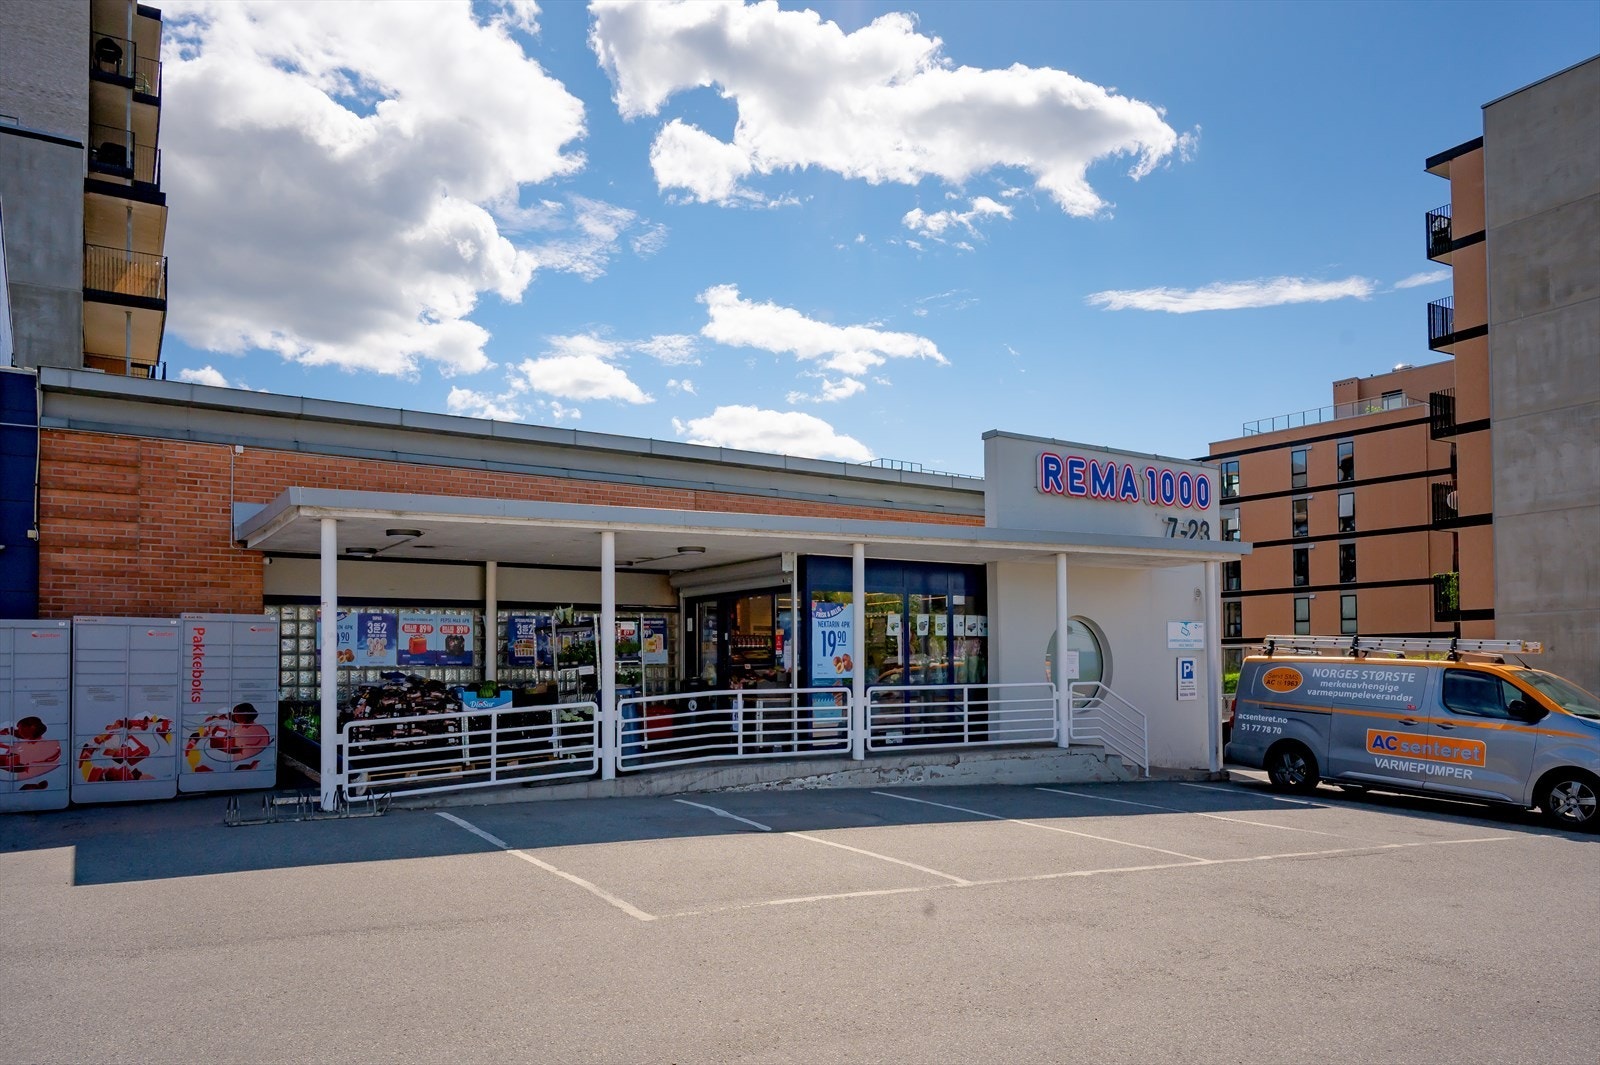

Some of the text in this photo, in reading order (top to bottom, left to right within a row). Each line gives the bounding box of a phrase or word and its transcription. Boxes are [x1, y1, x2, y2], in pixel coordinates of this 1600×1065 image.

[1040, 452, 1211, 511] REMA 1000
[1167, 516, 1210, 540] 7-23
[367, 622, 387, 634] 3 FOR 2
[817, 620, 840, 628] NEKTARIN
[341, 631, 350, 642] 90
[821, 630, 847, 657] 19 90
[191, 627, 206, 704] Pakkeboks
[1183, 662, 1191, 678] P
[1284, 673, 1299, 681] SMS
[1312, 668, 1416, 683] NORGES STØRSTE
[1319, 680, 1400, 693] merkeuavhengige
[1307, 688, 1414, 703] varmepumpeleverandør
[1238, 712, 1288, 724] acsenteret.no
[1241, 723, 1282, 735] 51 77 78 70
[1372, 734, 1481, 761] AC senteret
[1374, 757, 1474, 780] VARMEPUMPER
